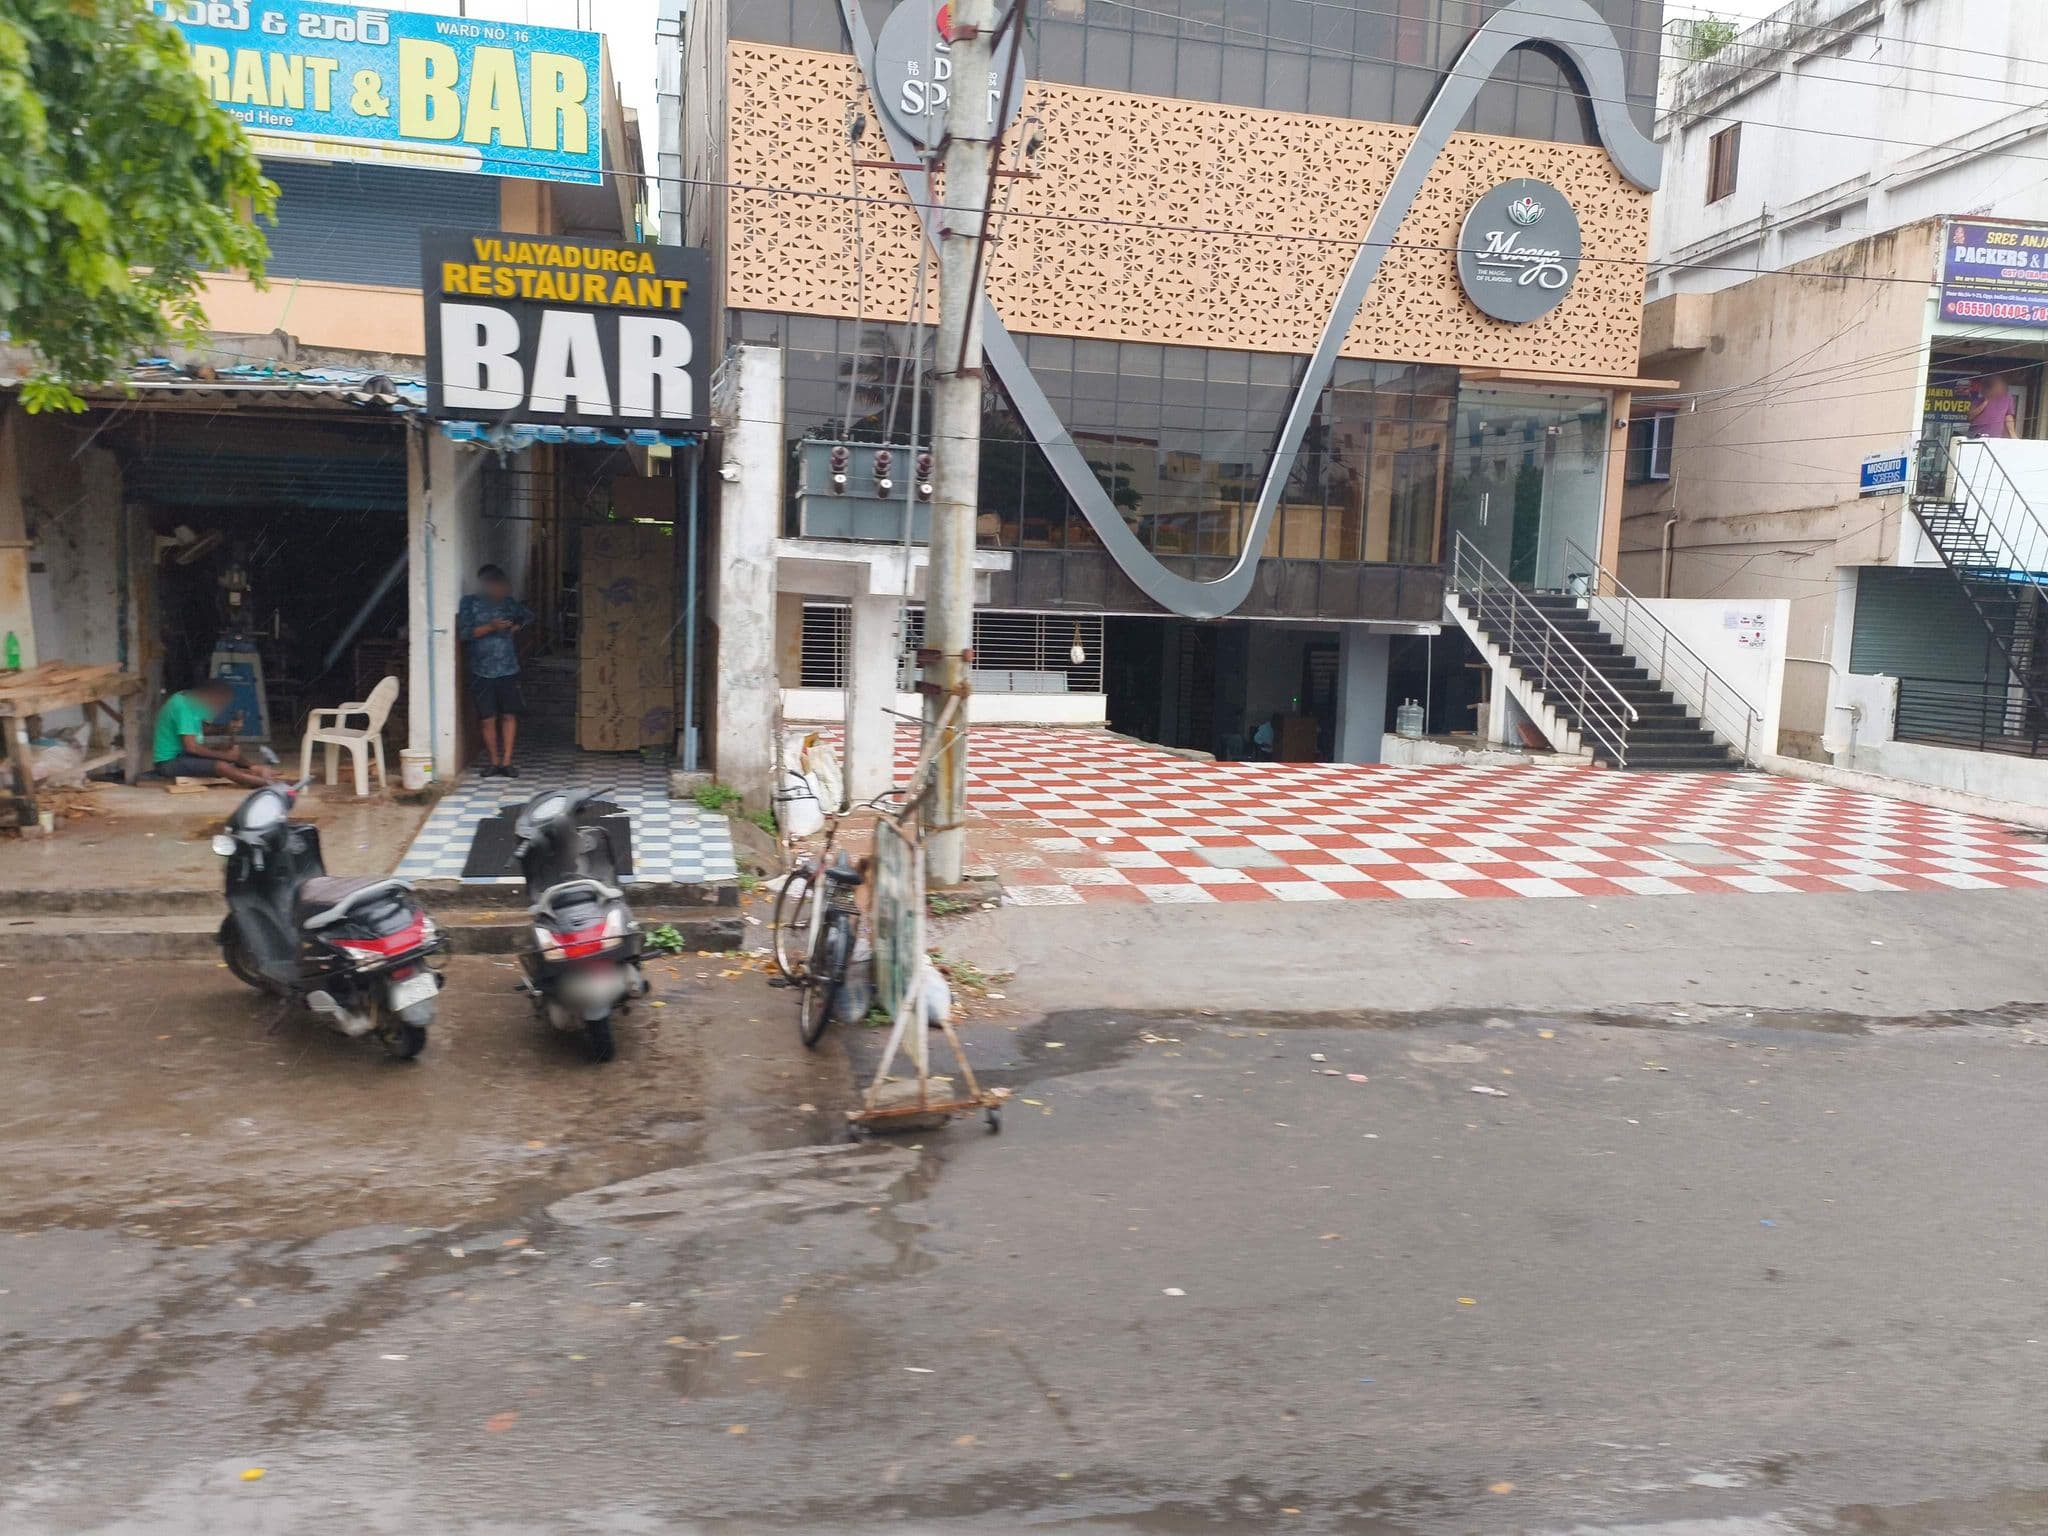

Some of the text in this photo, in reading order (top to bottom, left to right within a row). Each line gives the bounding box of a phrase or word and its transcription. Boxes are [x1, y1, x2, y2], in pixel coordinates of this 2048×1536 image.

[261, 11, 287, 35] &
[298, 10, 390, 46] బార్
[436, 22, 480, 38] WARD
[514, 31, 529, 43] 16
[189, 43, 338, 113] RANT
[351, 69, 390, 118] &
[399, 37, 589, 155] BAR
[901, 79, 1000, 124] SPT
[258, 110, 294, 127] Here
[1986, 231, 2018, 246] SREE
[473, 238, 656, 274] VIJAYADURGA
[1954, 245, 2028, 267] PACKERS
[2029, 253, 2041, 268] &
[442, 262, 688, 309] RESTAURANT
[1956, 301, 1992, 317] 85550
[2032, 306, 2048, 321] 70
[440, 302, 693, 420] BAR
[1934, 400, 1971, 412] MOVER
[1866, 459, 1901, 475] MOSQUITO
